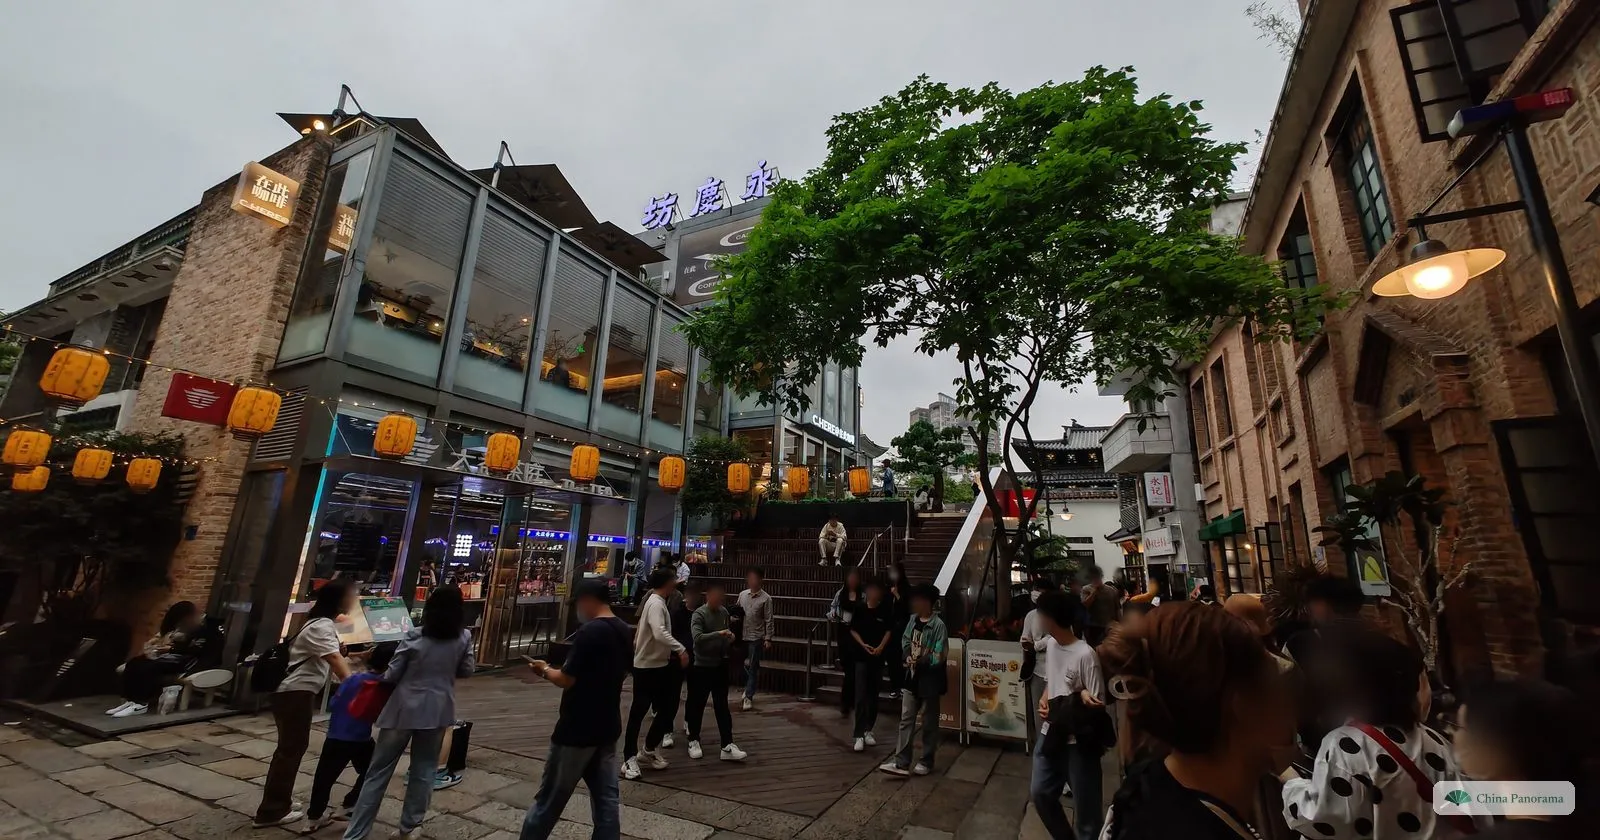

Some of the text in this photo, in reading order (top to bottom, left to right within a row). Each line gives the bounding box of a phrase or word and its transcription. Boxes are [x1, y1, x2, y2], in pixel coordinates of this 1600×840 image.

[251, 184, 289, 209] 咖啡
[256, 174, 290, 199] 在此
[589, 483, 613, 496] TEA
